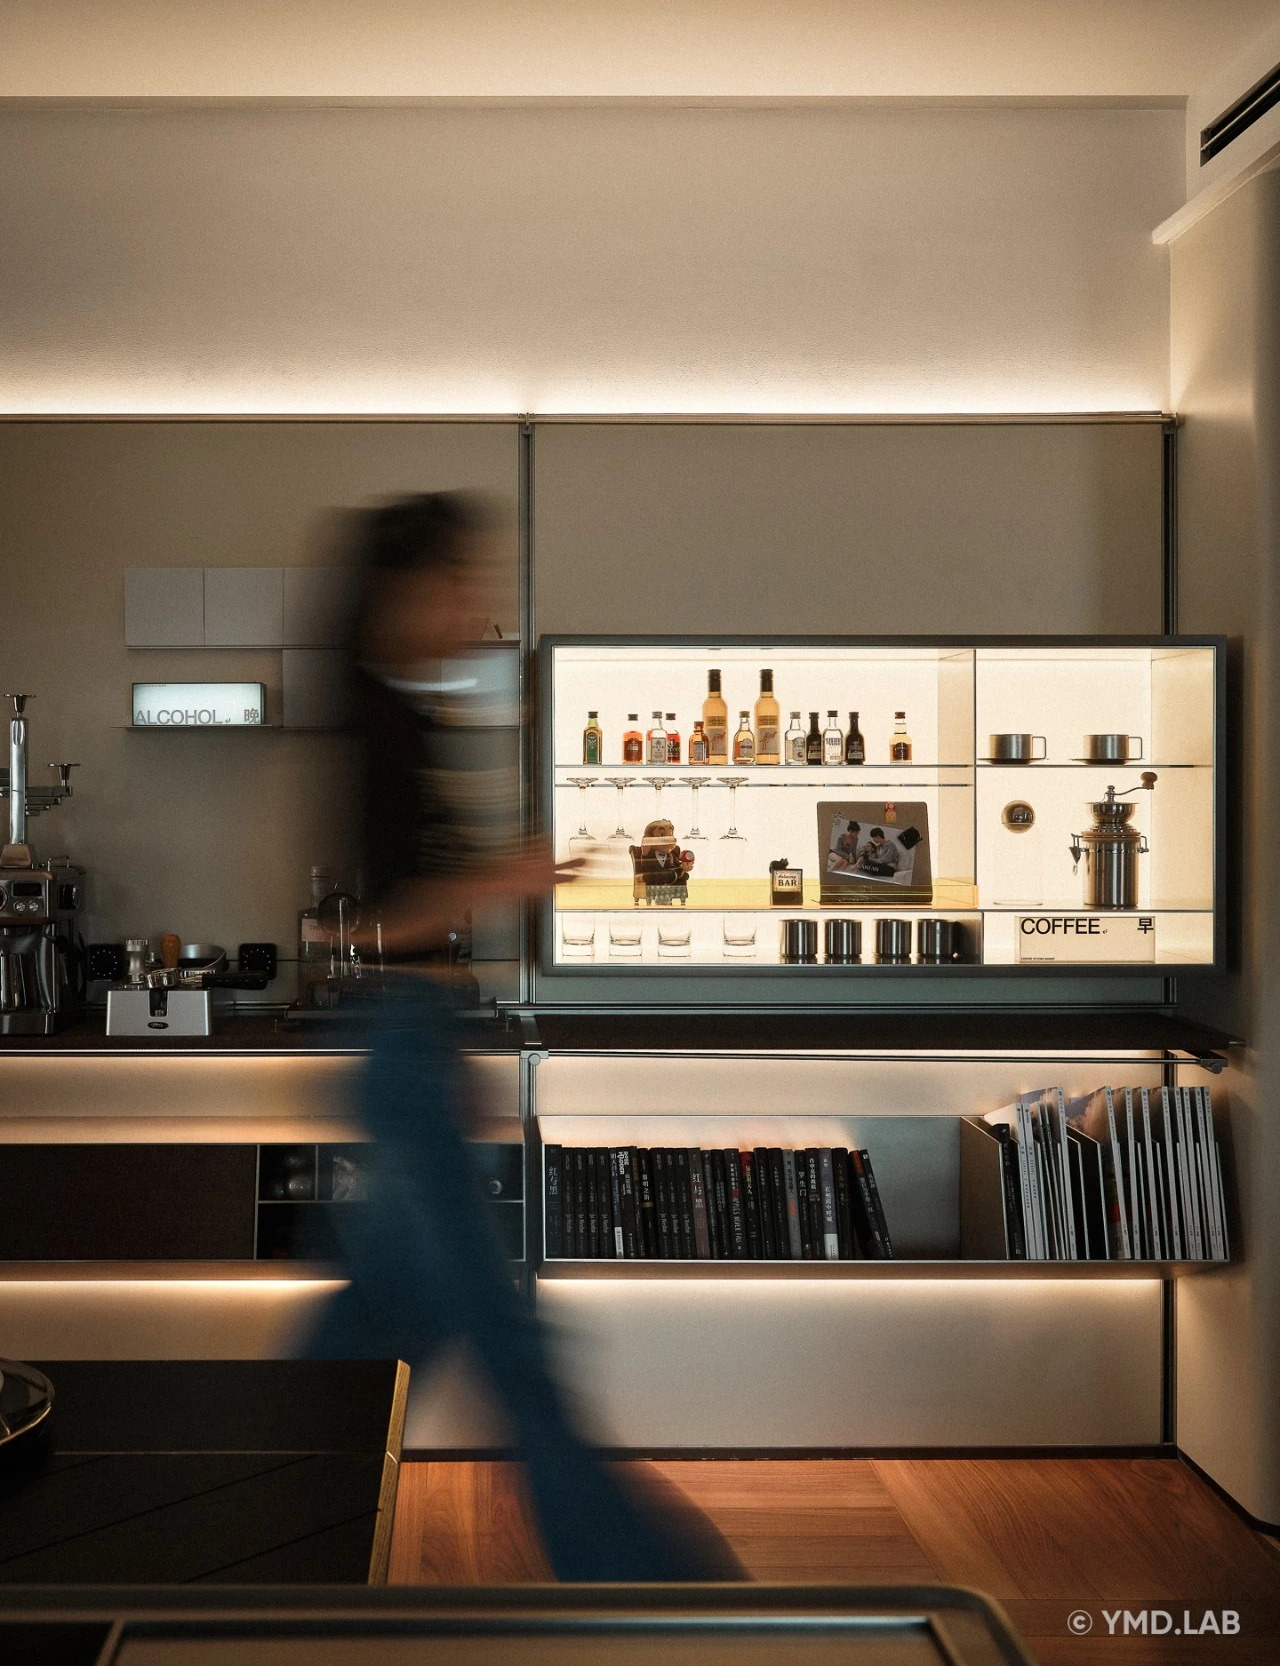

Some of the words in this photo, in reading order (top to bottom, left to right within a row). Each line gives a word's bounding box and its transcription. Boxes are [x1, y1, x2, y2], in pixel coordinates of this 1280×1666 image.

[134, 709, 223, 725] ALCOHOL
[243, 707, 260, 724] 晚
[778, 879, 797, 887] BAR
[1021, 918, 1101, 935] COFFEE
[1137, 917, 1154, 935] 早
[548, 1166, 559, 1195] 红与黑
[798, 1171, 807, 1197] 罗生门
[692, 1173, 704, 1209] 红与黑
